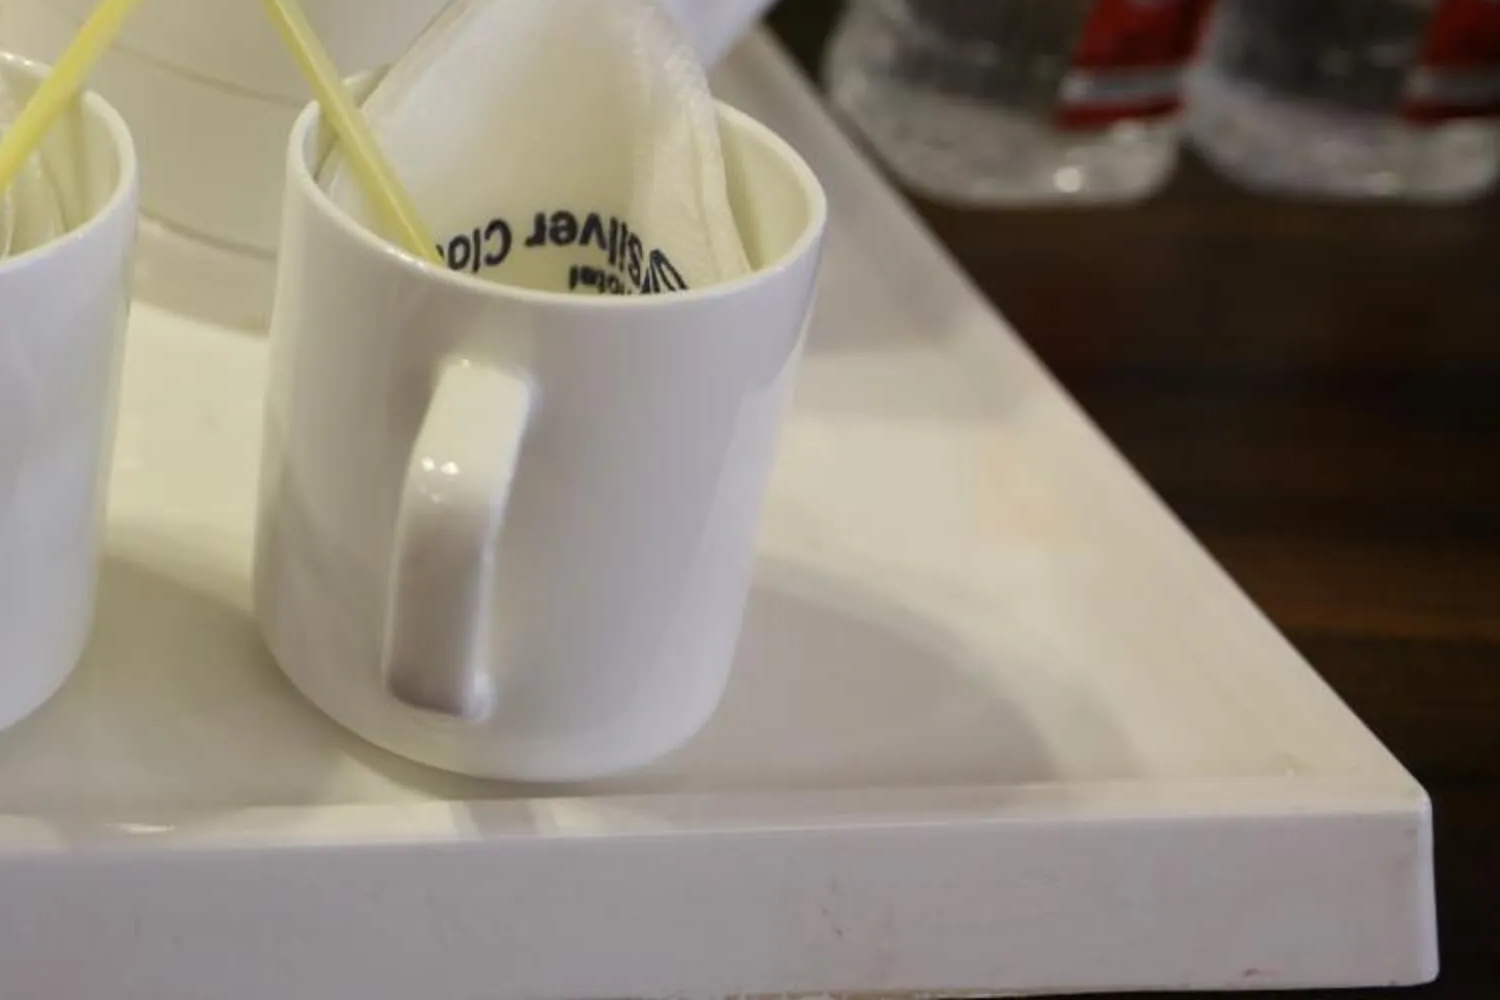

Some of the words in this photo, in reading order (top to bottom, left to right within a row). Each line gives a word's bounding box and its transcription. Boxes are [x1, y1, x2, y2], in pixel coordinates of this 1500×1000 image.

[434, 219, 512, 274] Clo
[524, 210, 644, 290] Silver
[568, 265, 632, 297] otel
